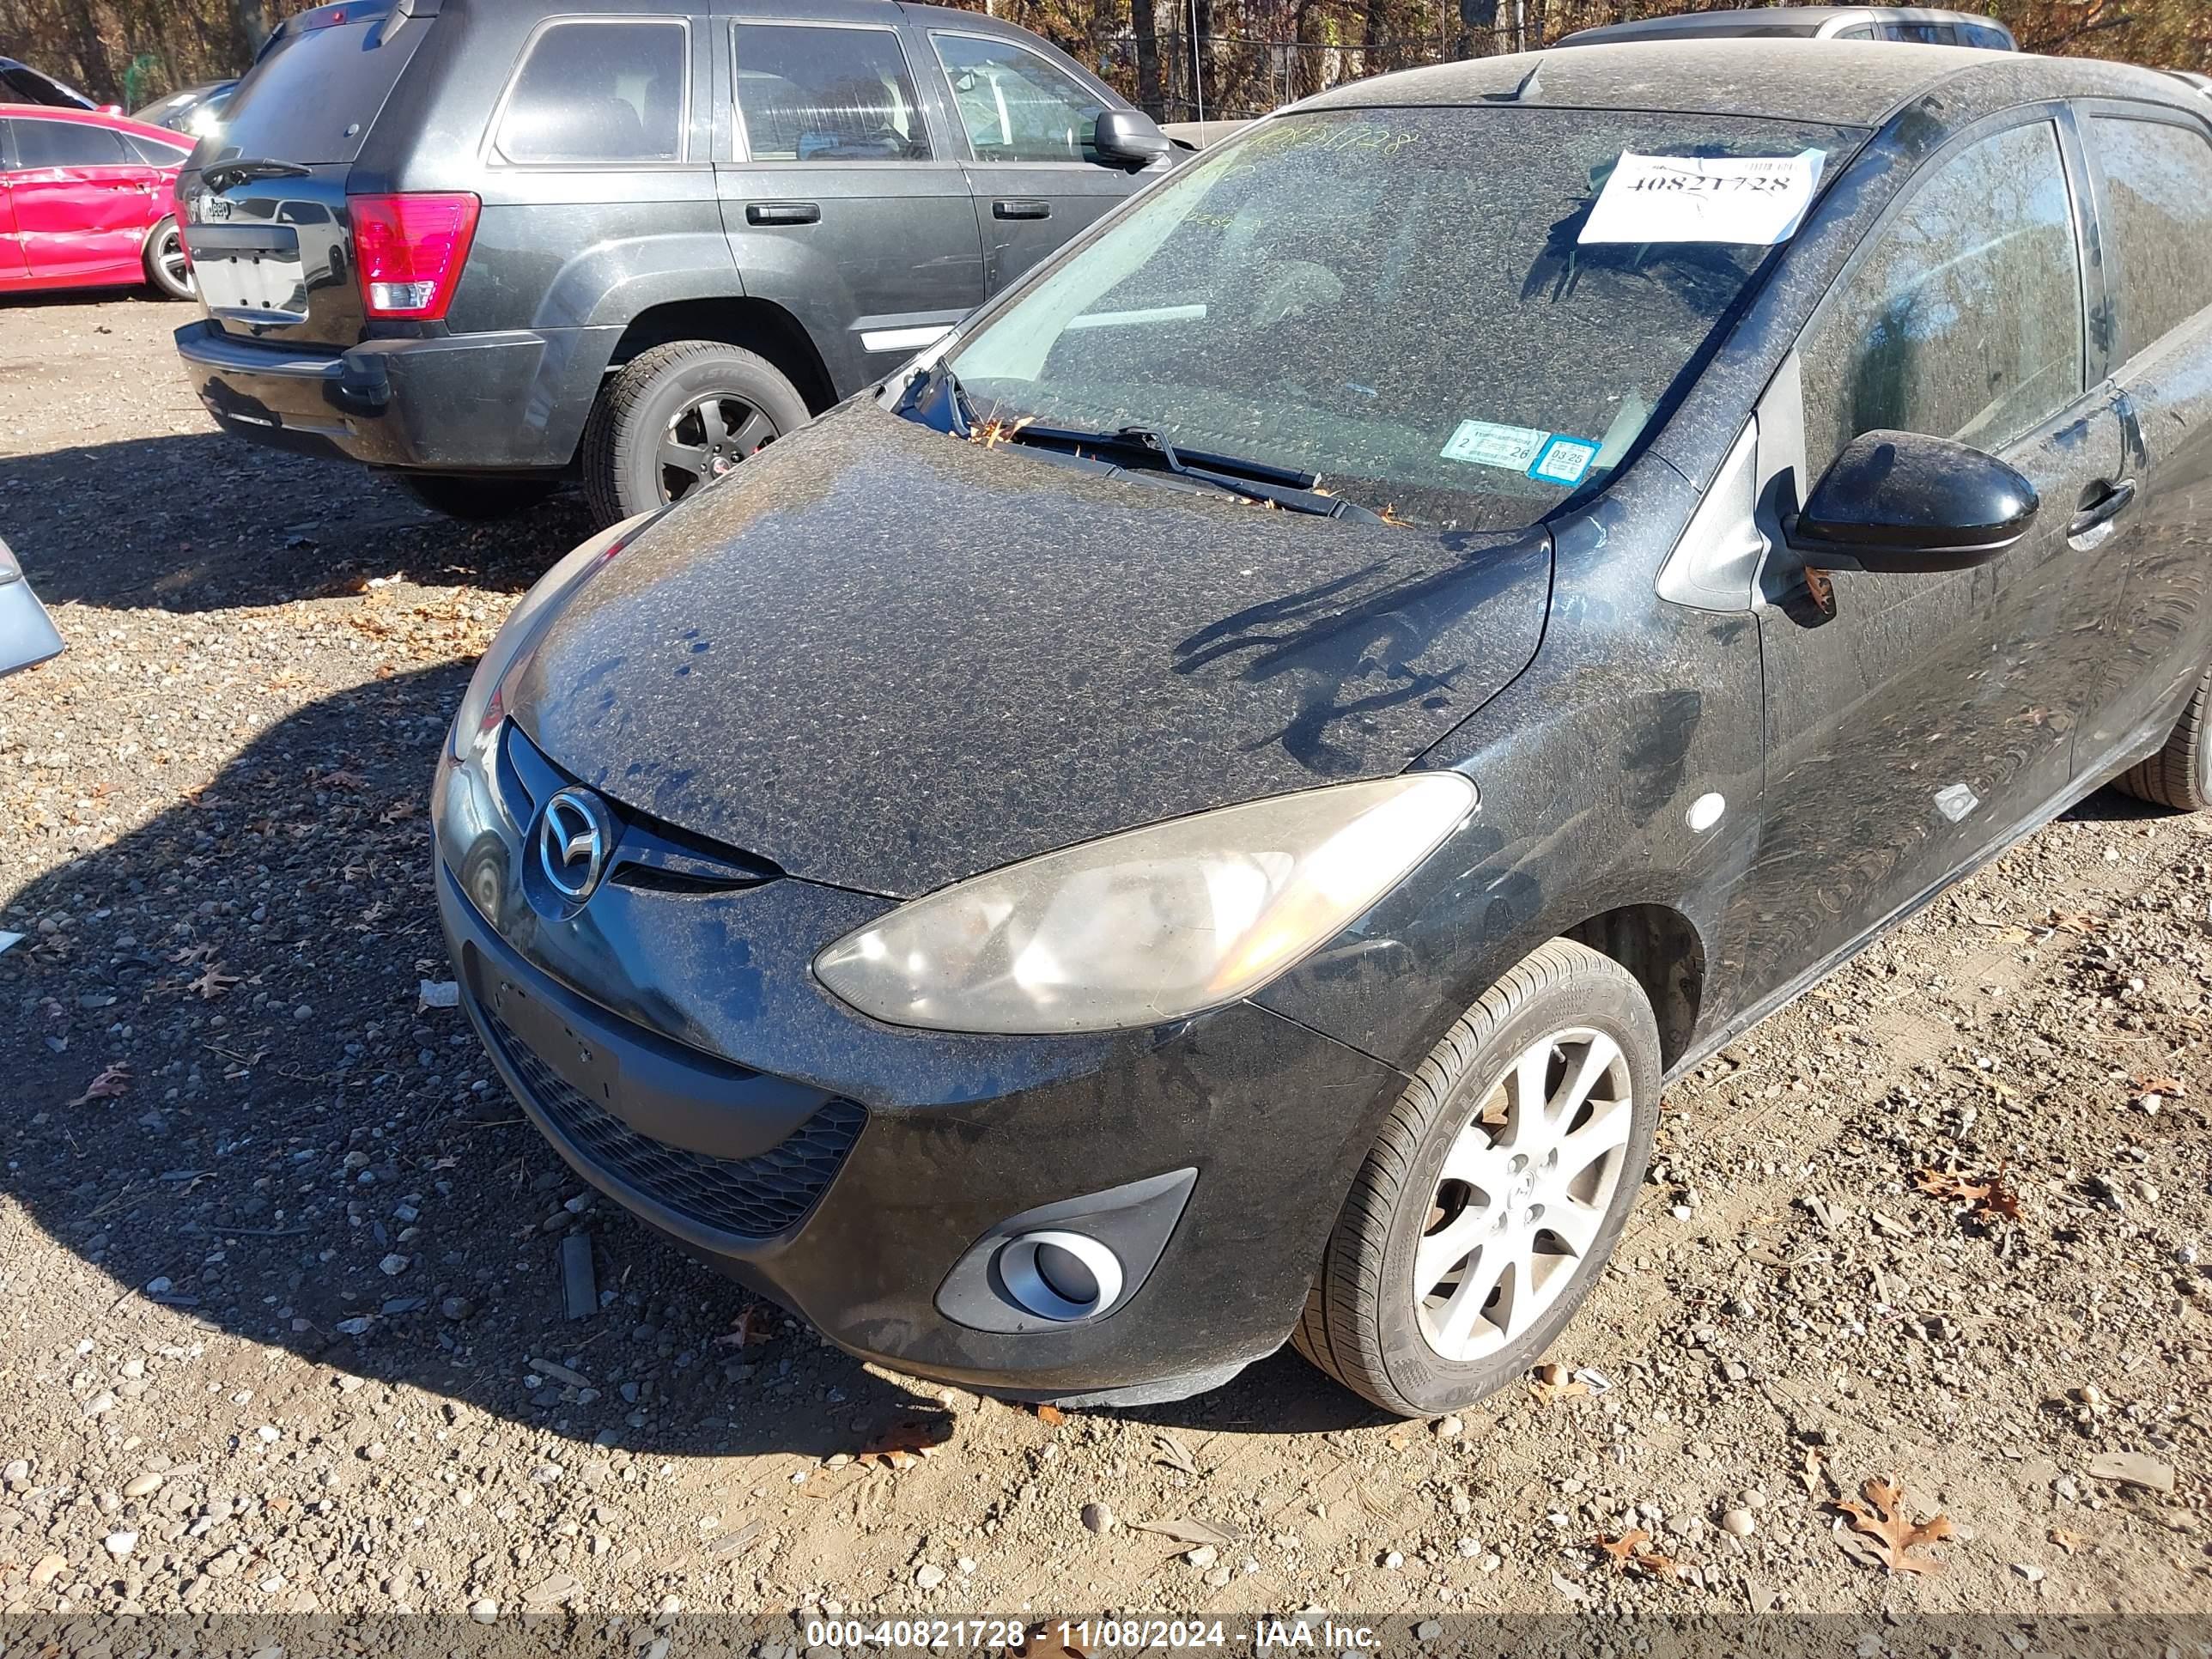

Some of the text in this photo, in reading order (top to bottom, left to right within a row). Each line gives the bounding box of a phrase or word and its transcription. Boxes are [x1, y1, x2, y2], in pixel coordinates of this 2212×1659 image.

[1628, 175, 1791, 192] 40821728
[208, 198, 231, 220] Jeep
[1457, 438, 1470, 448] 2
[1509, 446, 1531, 459] 26
